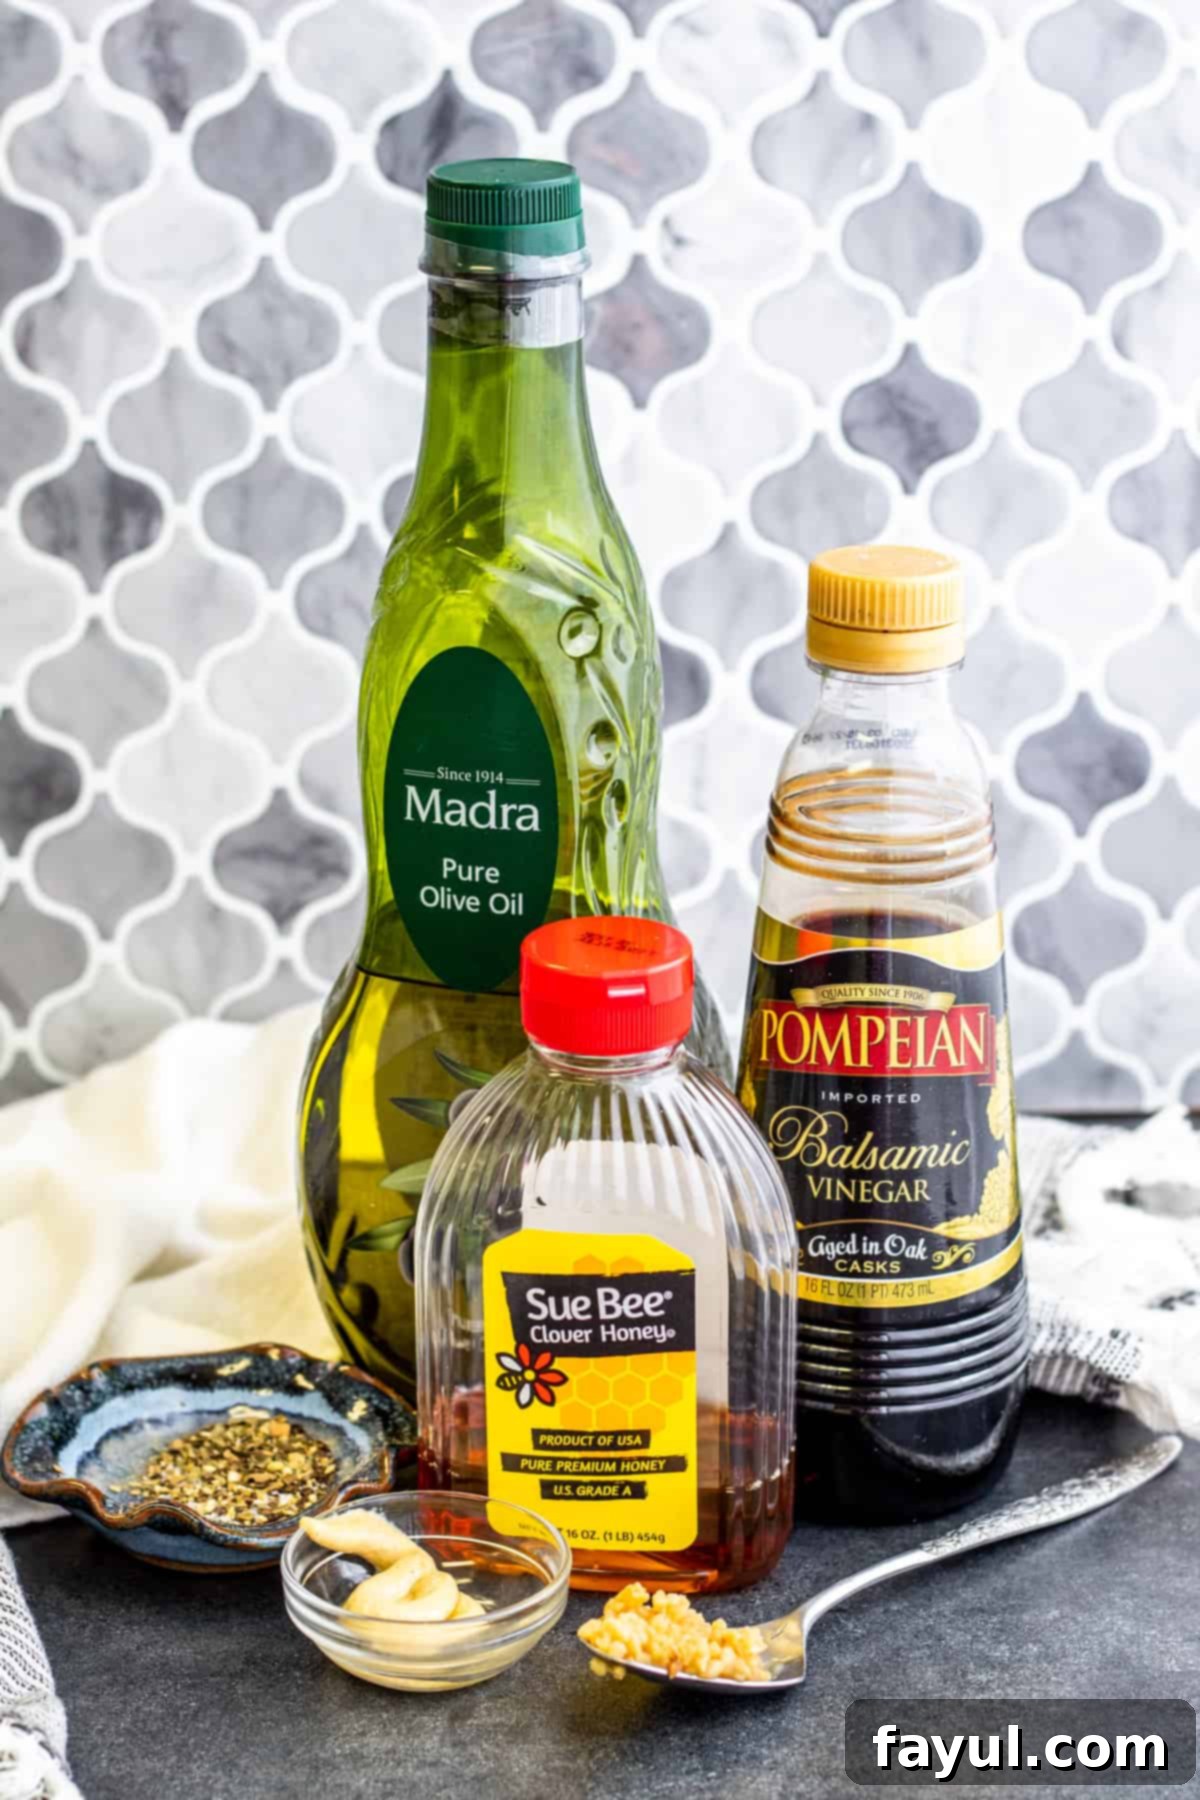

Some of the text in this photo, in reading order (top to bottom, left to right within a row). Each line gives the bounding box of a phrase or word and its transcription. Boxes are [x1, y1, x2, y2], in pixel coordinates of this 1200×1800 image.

[436, 766, 504, 784] Since 1914
[403, 784, 542, 832] Madra
[442, 857, 500, 884] Pure
[419, 885, 524, 916] Olive Oil
[821, 987, 925, 1001] QUALITY SINCE 1906
[760, 1009, 987, 1069] POMPEIAN
[821, 1091, 922, 1104] IMPORTED
[769, 1105, 971, 1170] Balsamic
[806, 1174, 932, 1204] VINEGAR
[808, 1232, 928, 1261] Aged in Oak
[834, 1259, 901, 1274] CASKS
[804, 1277, 818, 1294] 16
[821, 1279, 834, 1296] FL
[838, 1282, 854, 1298] OZ
[892, 1282, 916, 1299] 473
[525, 1287, 592, 1321] Sue
[530, 1324, 593, 1343] Clover
[539, 1434, 642, 1447] PRODUCT OF USA
[520, 1458, 667, 1472] PURE PREMIUM HONEY
[553, 1485, 632, 1497] U.S. GRADE A
[566, 1529, 579, 1540] 16
[581, 1529, 600, 1541] OZ.
[603, 1531, 613, 1543] (1
[616, 1531, 634, 1543] LB)
[637, 1531, 666, 1544] 454g
